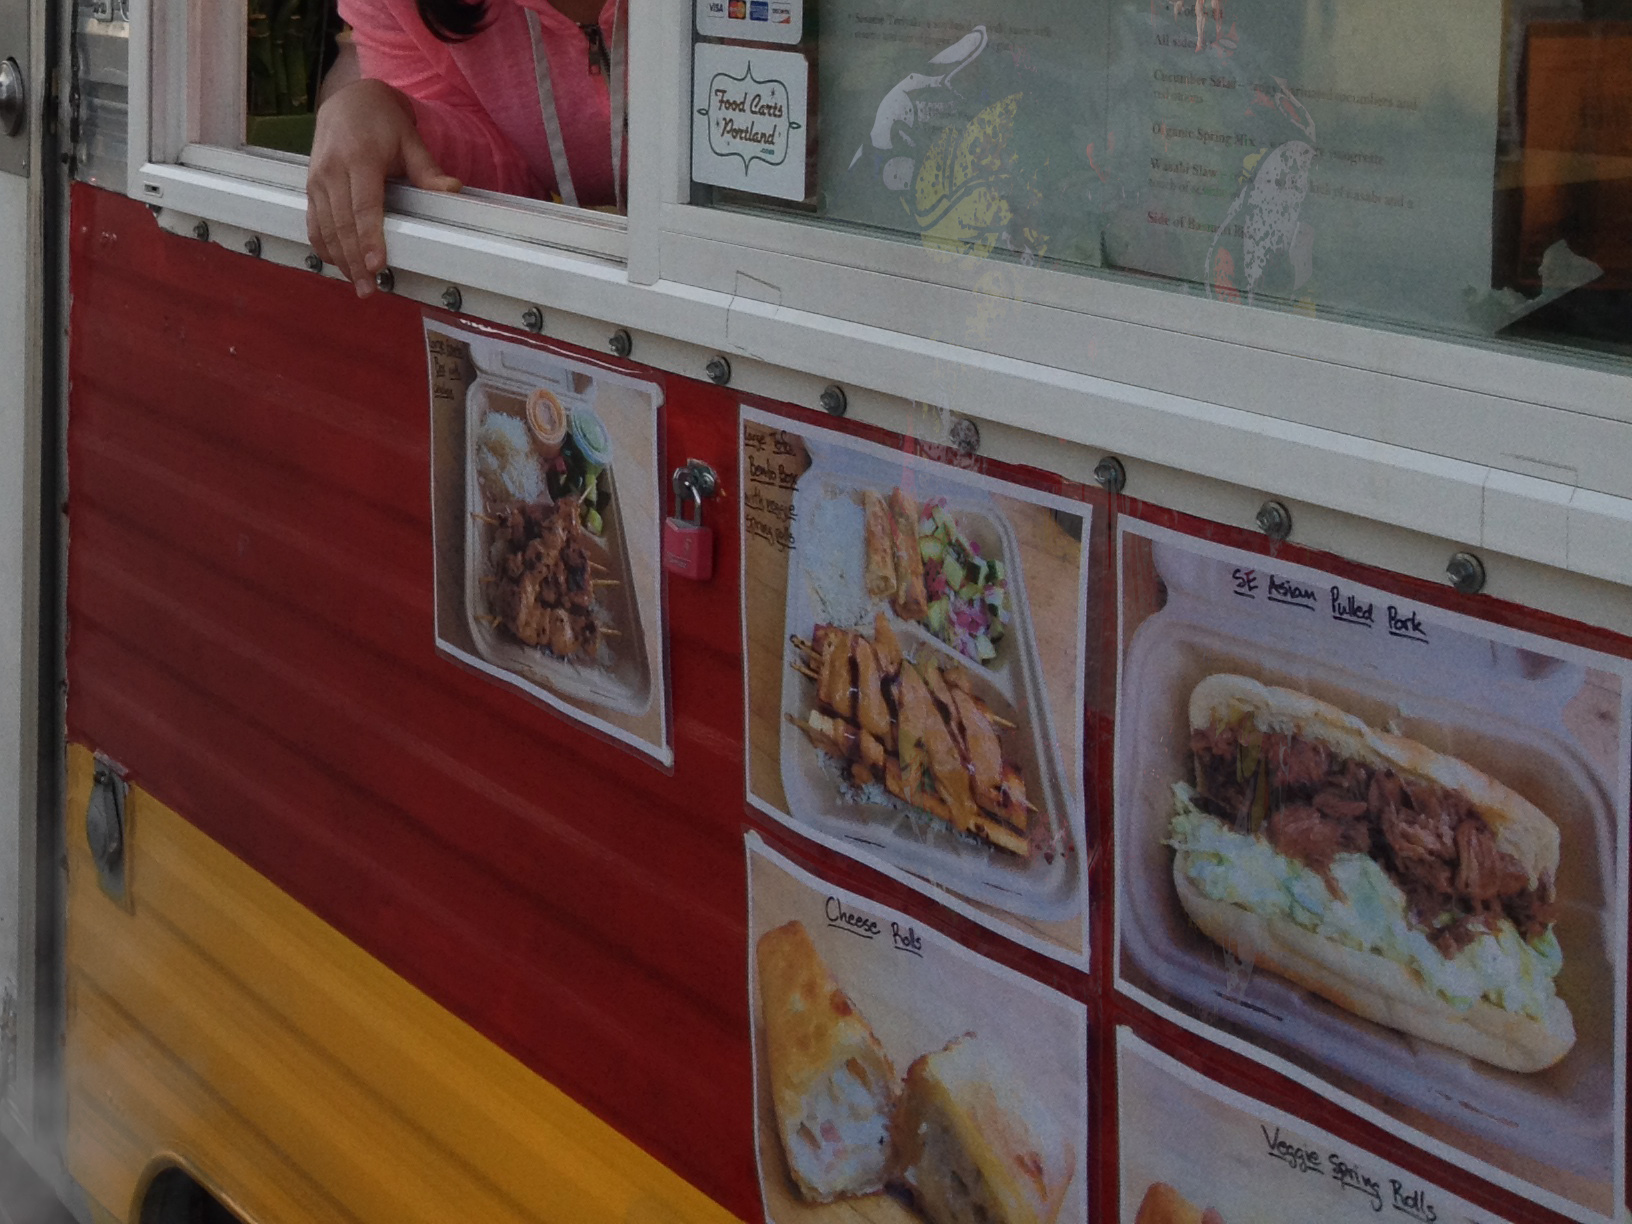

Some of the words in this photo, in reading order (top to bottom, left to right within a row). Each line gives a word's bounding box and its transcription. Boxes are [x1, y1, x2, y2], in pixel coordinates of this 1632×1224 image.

[709, 2, 724, 13] VISA
[715, 88, 746, 116] Food
[749, 91, 783, 118] Carts
[719, 117, 777, 145] Portland
[1197, 128, 1232, 147] Spring
[1232, 568, 1258, 592] SE
[1268, 574, 1317, 602] Asian
[1330, 586, 1374, 623] Pulled
[1387, 606, 1427, 636] Pork
[825, 896, 881, 935] Cheese
[1260, 1124, 1322, 1173] Veggie
[1328, 1153, 1383, 1212] Spring
[1389, 1178, 1437, 1222] Rolls
